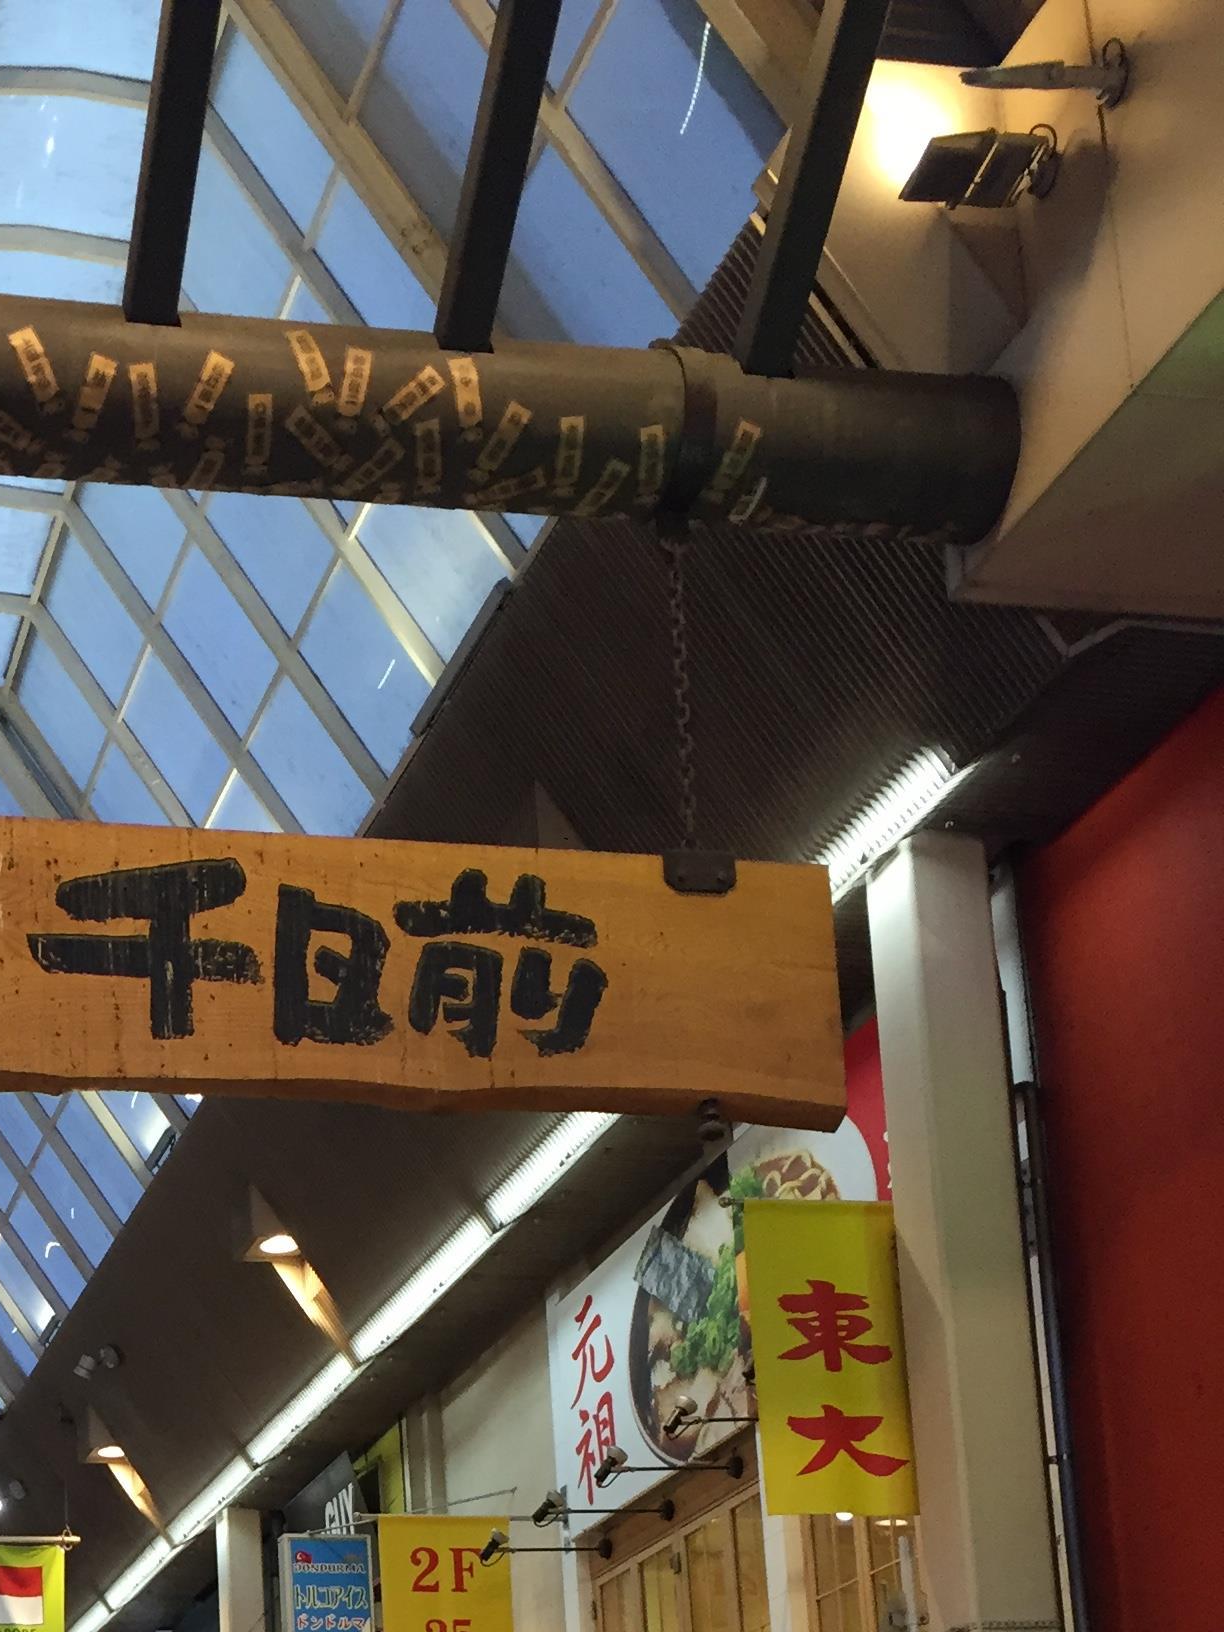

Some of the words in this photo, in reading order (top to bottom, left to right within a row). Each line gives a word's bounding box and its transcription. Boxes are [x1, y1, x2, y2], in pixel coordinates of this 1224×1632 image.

[25, 856, 608, 1058] 千日前
[570, 1295, 616, 1505] 元祖
[778, 1279, 910, 1478] 東大
[294, 1584, 368, 1610] トルコアイス
[296, 1613, 366, 1631] ドンドルマ
[410, 1546, 483, 1593] 2F
